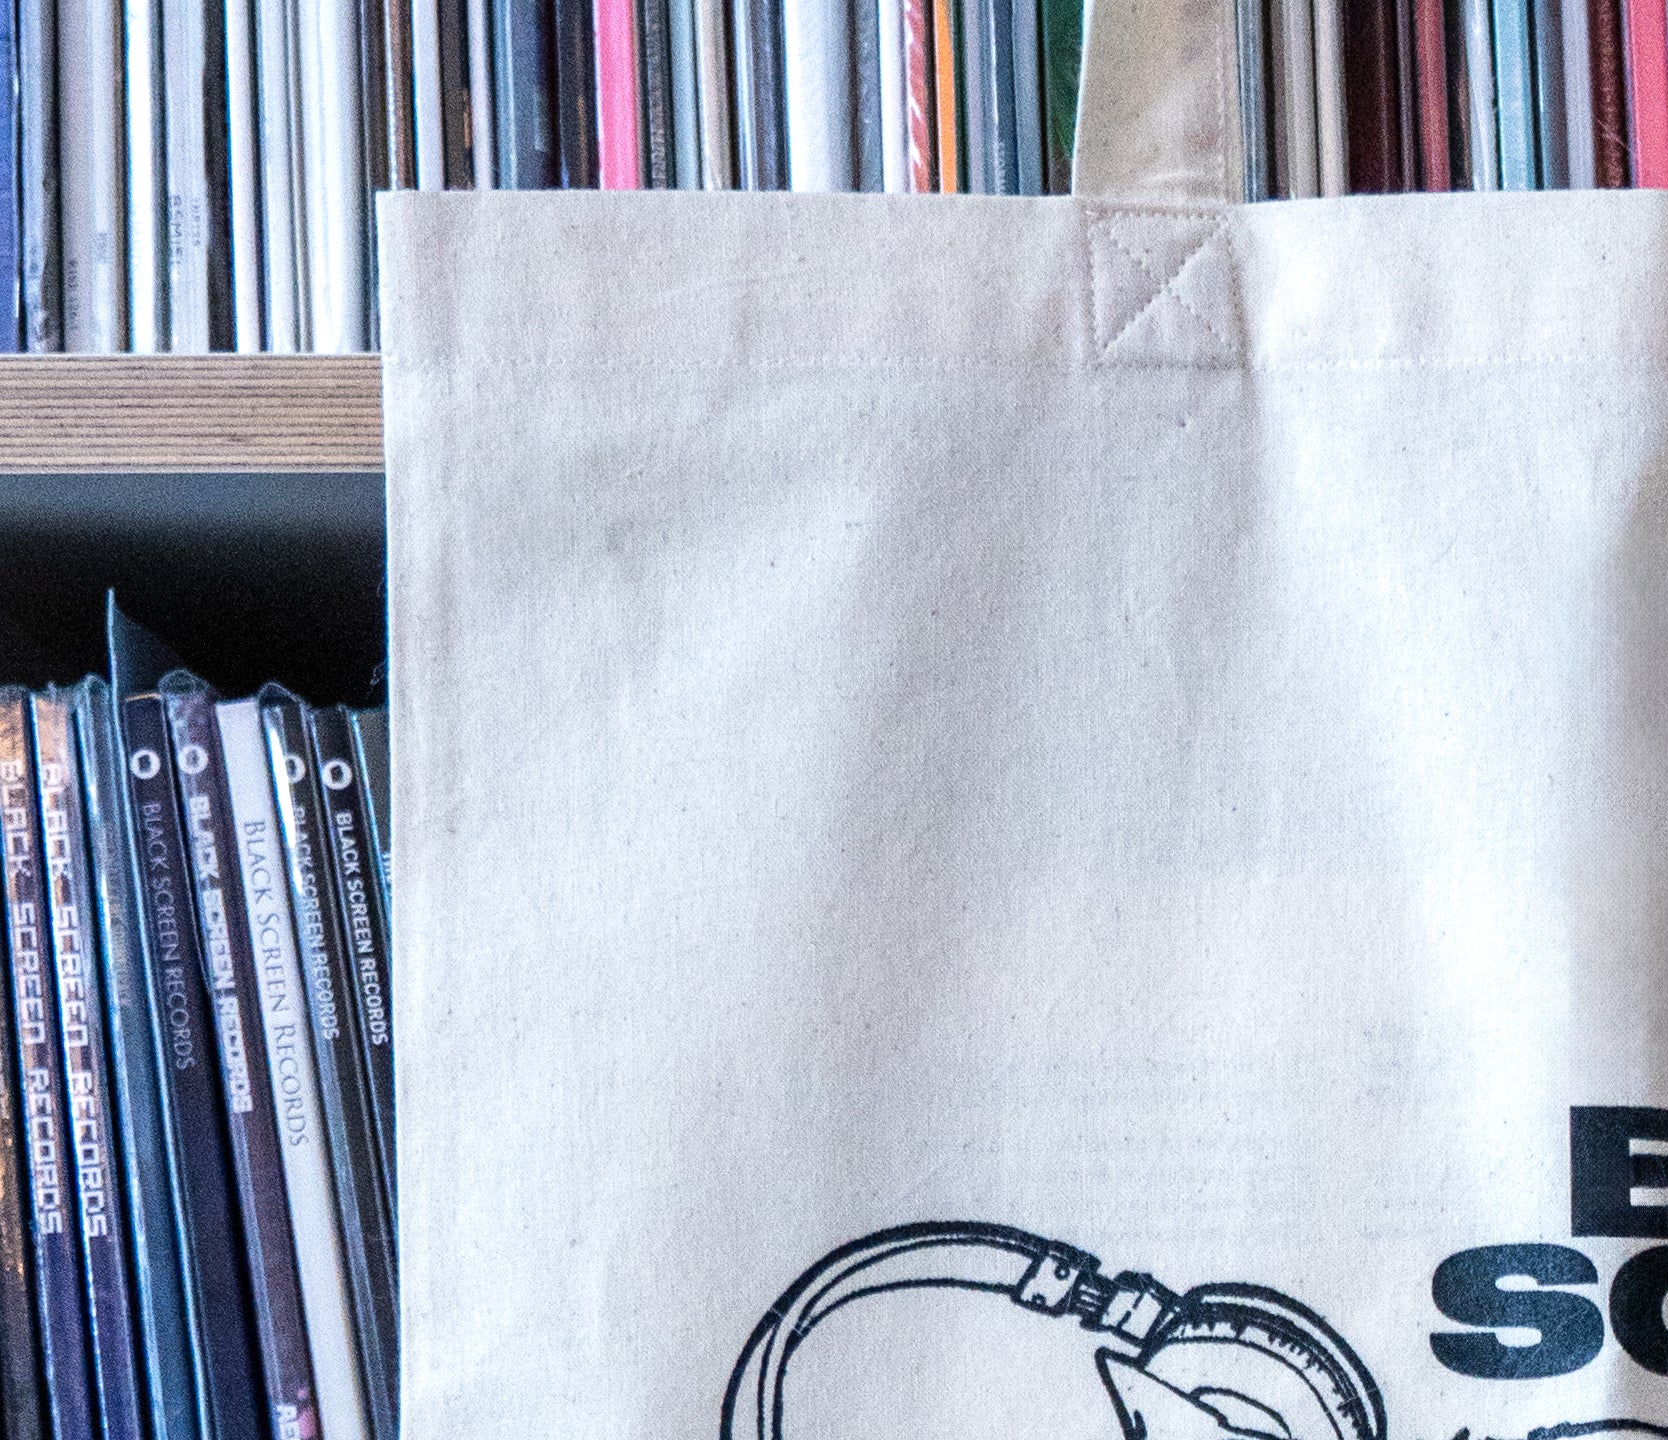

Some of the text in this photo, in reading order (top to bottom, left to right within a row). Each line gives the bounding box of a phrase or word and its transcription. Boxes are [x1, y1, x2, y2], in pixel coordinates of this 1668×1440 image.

[1, 759, 63, 1235] BLACK SCREEN RECORDS
[41, 763, 107, 1238] BLACK SCREEN RECORDS
[141, 802, 196, 1070] BLACK SCREEN RECORDS
[189, 795, 253, 1113] BLACK SCREEN RECORDS
[243, 819, 309, 1146] BLACK SCREEN RECORDS
[299, 873, 325, 949] SCREEN
[309, 955, 340, 1040] RECORDS
[335, 812, 388, 1045] BLACK SCREEN RECORDS
